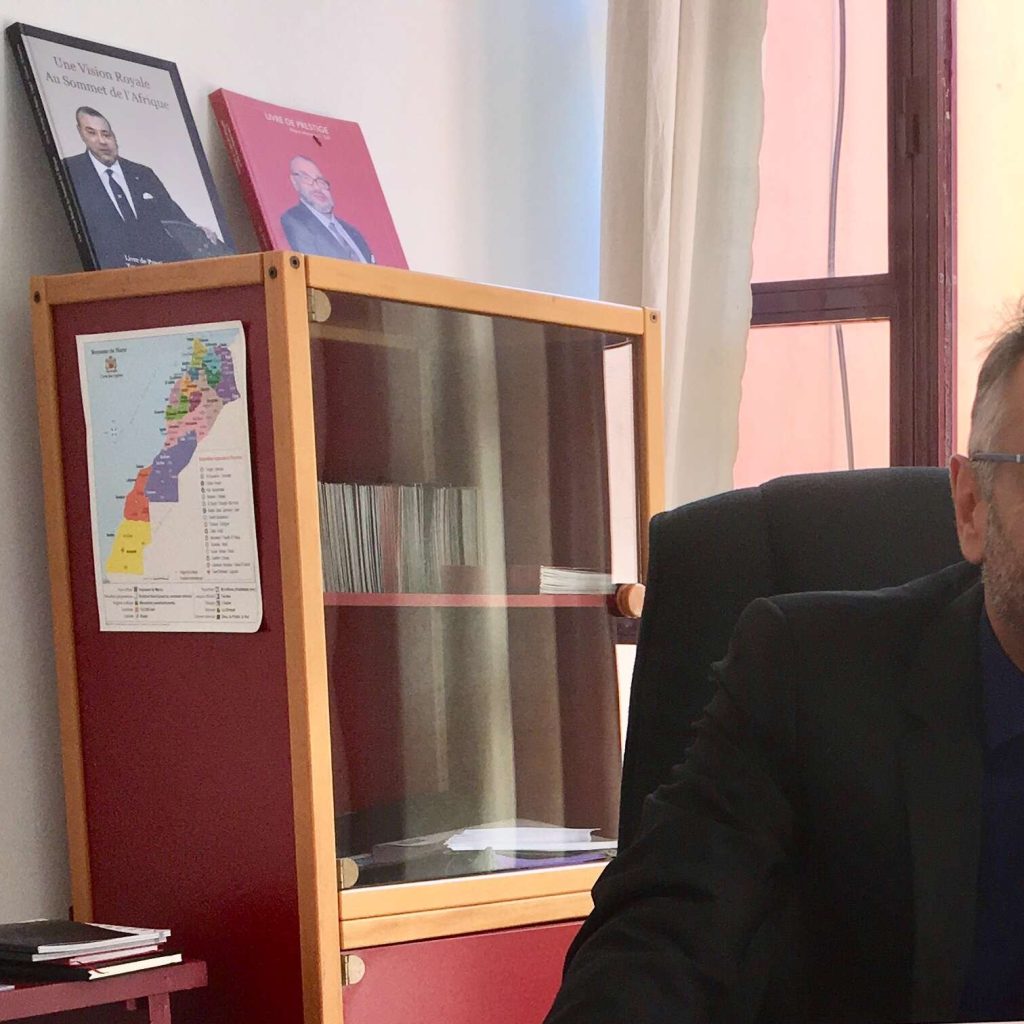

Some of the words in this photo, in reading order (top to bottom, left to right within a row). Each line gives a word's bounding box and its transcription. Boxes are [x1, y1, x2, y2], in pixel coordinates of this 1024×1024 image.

[53, 56, 76, 71] Une
[77, 62, 112, 80] Vision
[114, 71, 151, 88] Royale
[45, 72, 60, 84] Au
[62, 75, 108, 96] Sommet
[109, 87, 123, 99] de
[123, 90, 169, 110] l'Afrique
